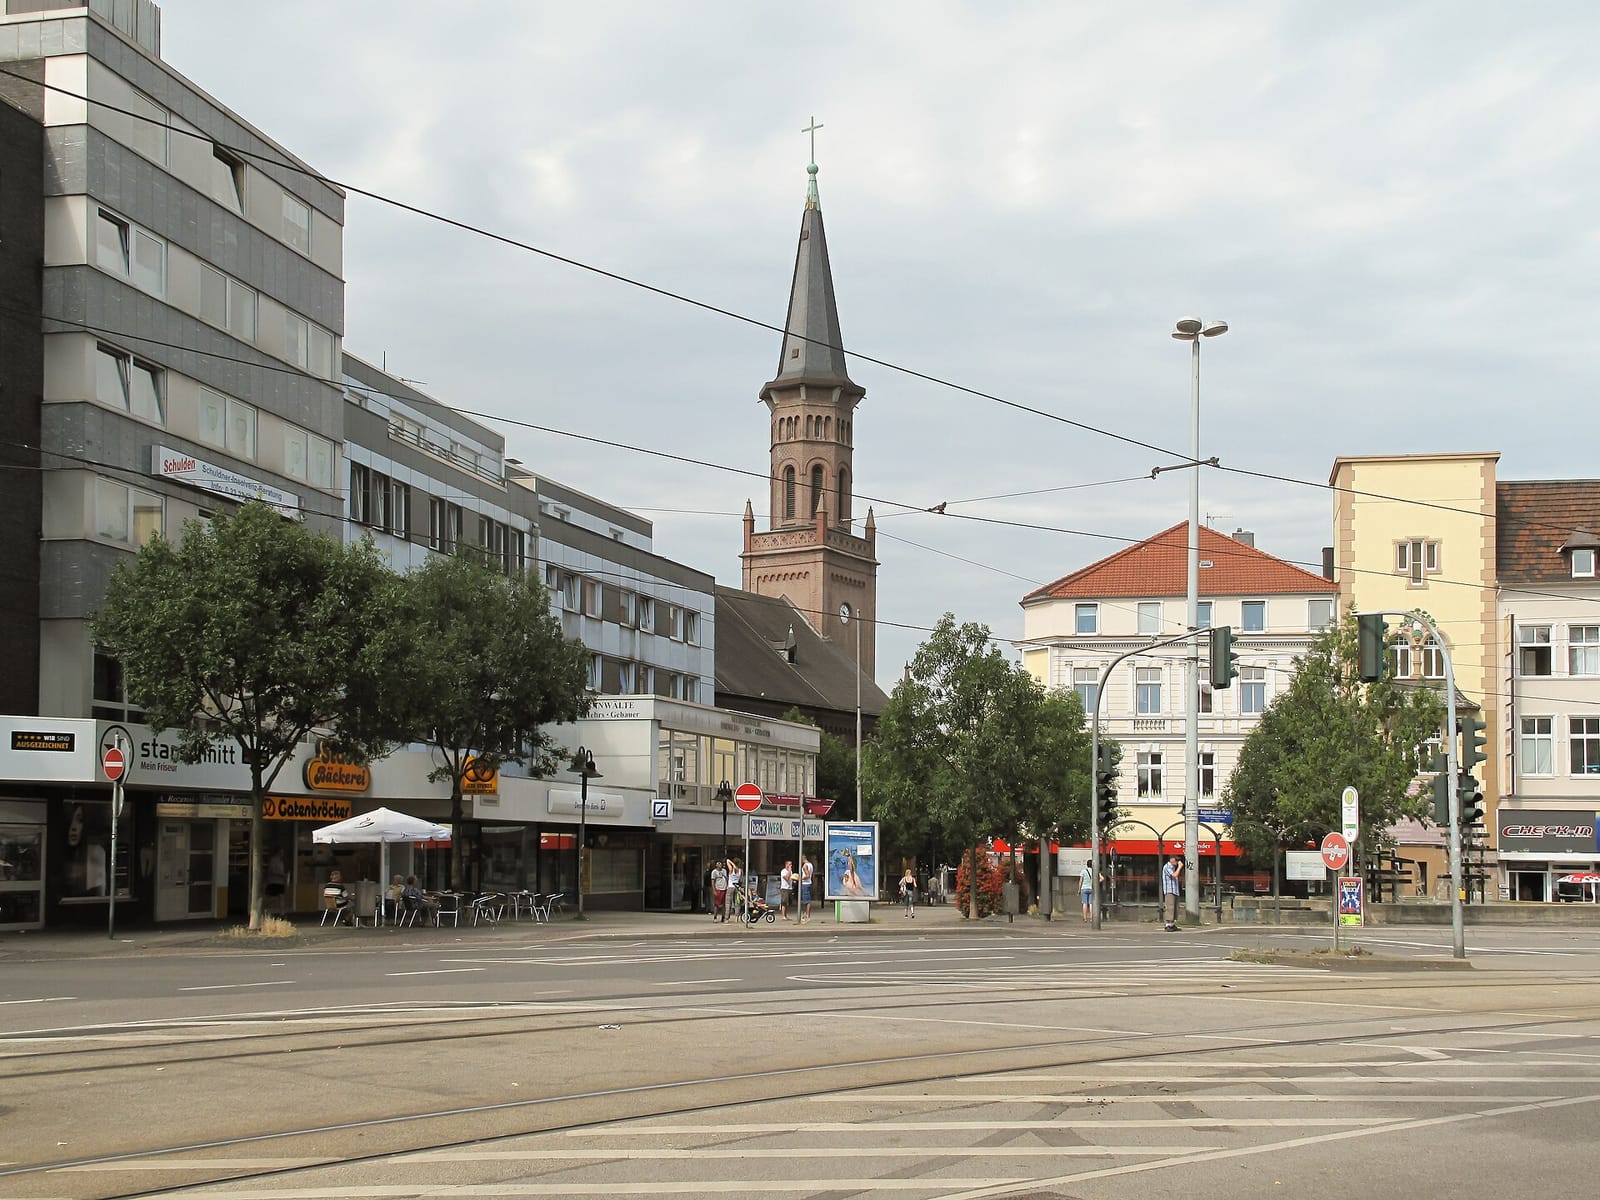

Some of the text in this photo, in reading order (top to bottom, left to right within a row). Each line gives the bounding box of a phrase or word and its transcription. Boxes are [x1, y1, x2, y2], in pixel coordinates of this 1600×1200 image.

[163, 457, 196, 473] Schulden
[16, 741, 69, 749] AUSGEZEICHNET
[140, 761, 178, 772] Mein Friseur
[314, 765, 366, 786] Bäckerei
[278, 799, 350, 818] Gatenbröcker
